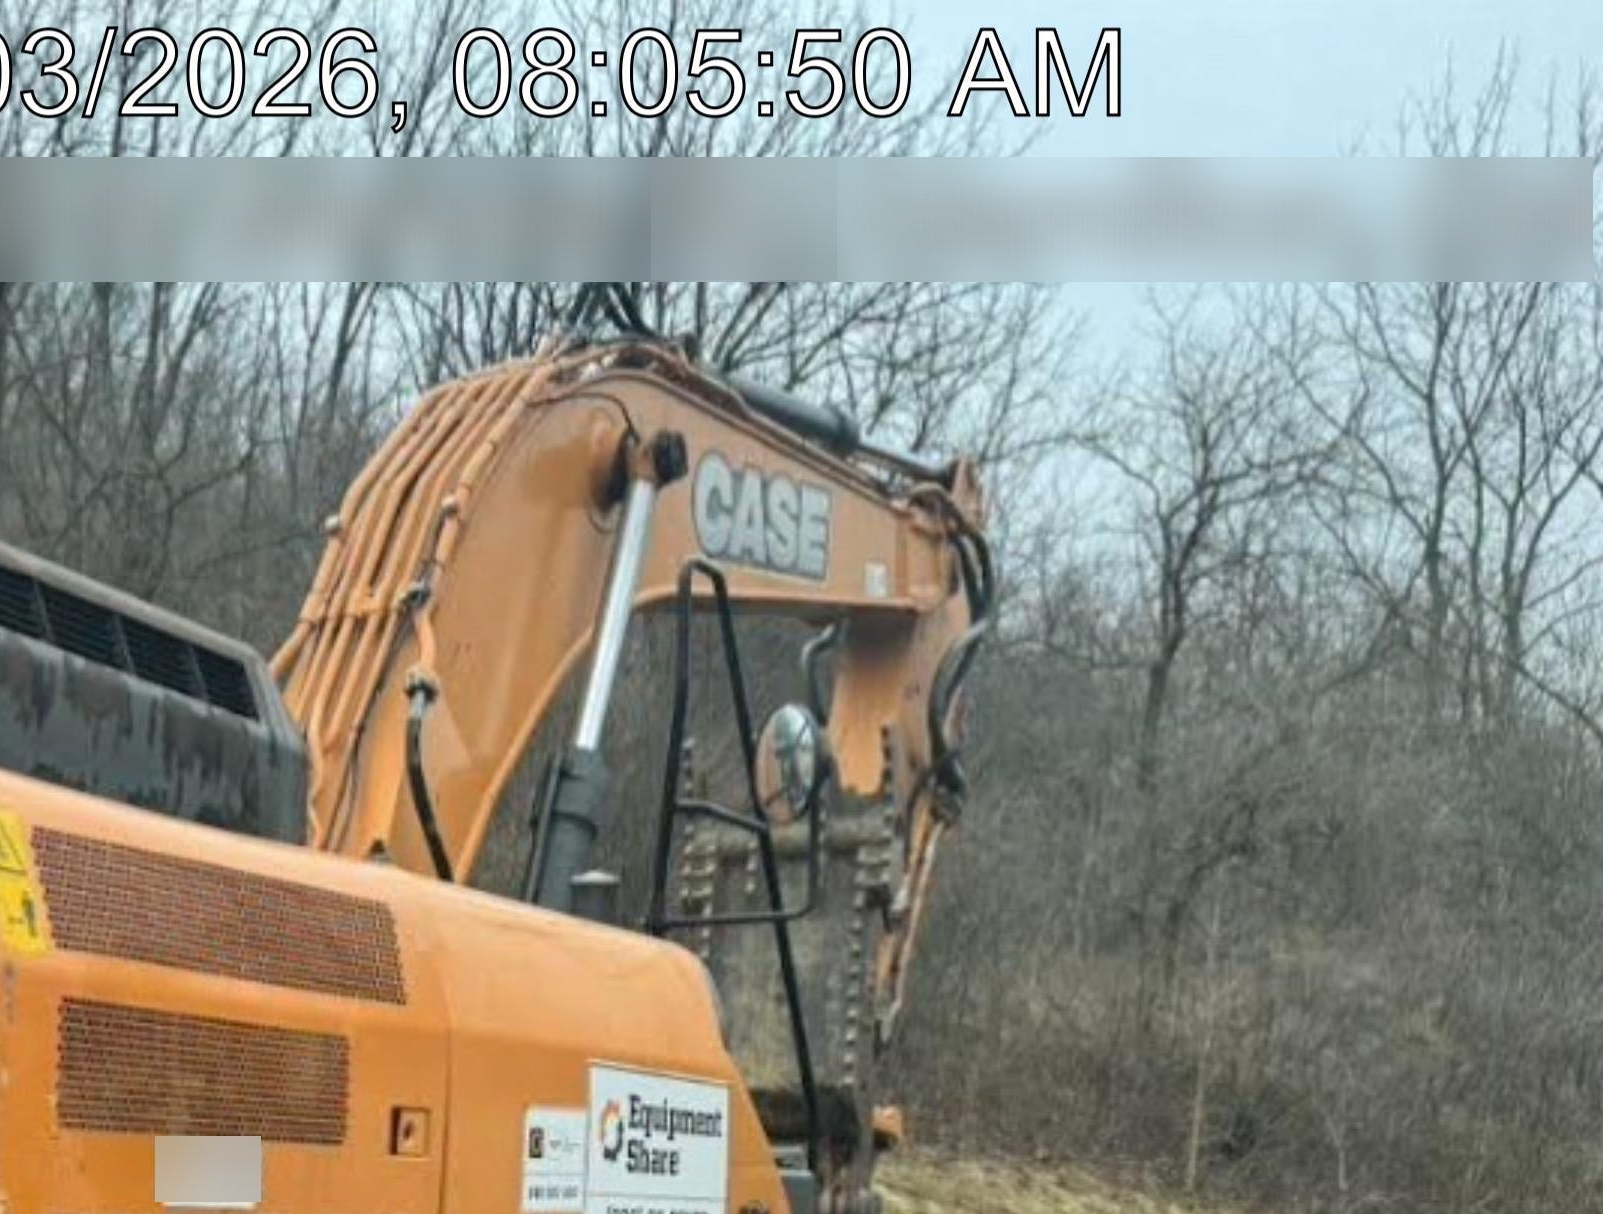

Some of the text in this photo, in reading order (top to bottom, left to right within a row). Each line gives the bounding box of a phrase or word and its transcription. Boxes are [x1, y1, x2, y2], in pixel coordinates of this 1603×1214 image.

[694, 451, 830, 580] CASE
[628, 1095, 721, 1140] Equipment
[627, 1140, 680, 1175] Share
